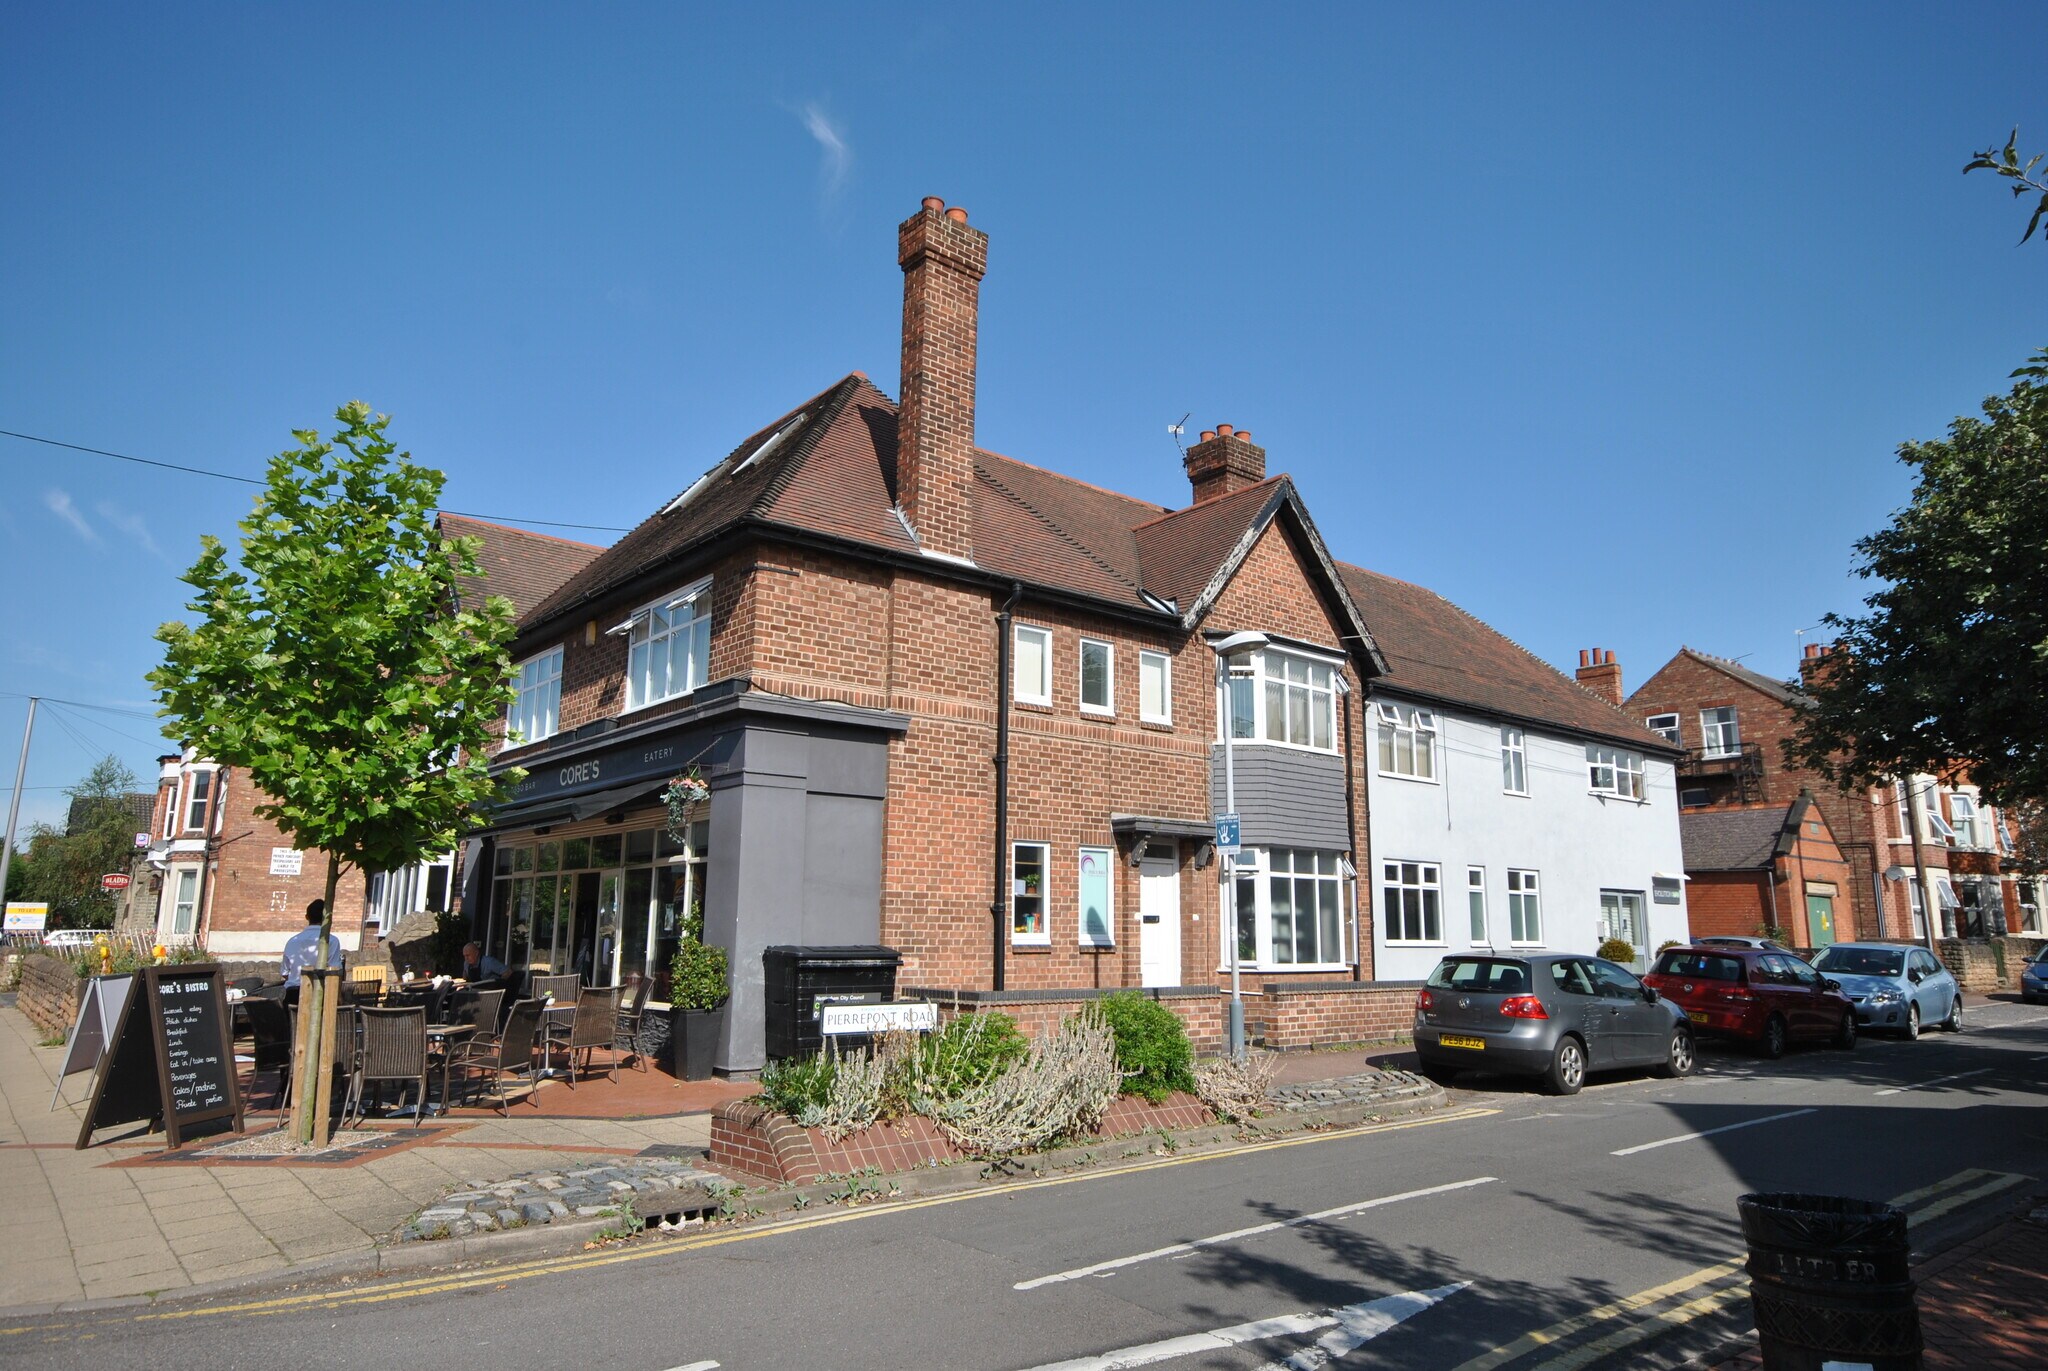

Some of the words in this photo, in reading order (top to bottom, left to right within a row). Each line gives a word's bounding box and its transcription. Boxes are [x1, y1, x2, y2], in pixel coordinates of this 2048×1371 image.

[644, 746, 674, 764] EATERY
[559, 759, 600, 787] CORE'S
[524, 781, 536, 792] BAR
[185, 982, 209, 993] BISTRO
[827, 1012, 897, 1026] PIERREPONT
[903, 1011, 935, 1023] ROAD
[1443, 1035, 1464, 1046] PE56
[1465, 1037, 1482, 1048] DJZ
[169, 1060, 180, 1069] Eat
[170, 1072, 197, 1083] Beverages
[175, 1099, 197, 1110] Private
[205, 1094, 223, 1107] parties
[1777, 1253, 1877, 1281] LITTER
